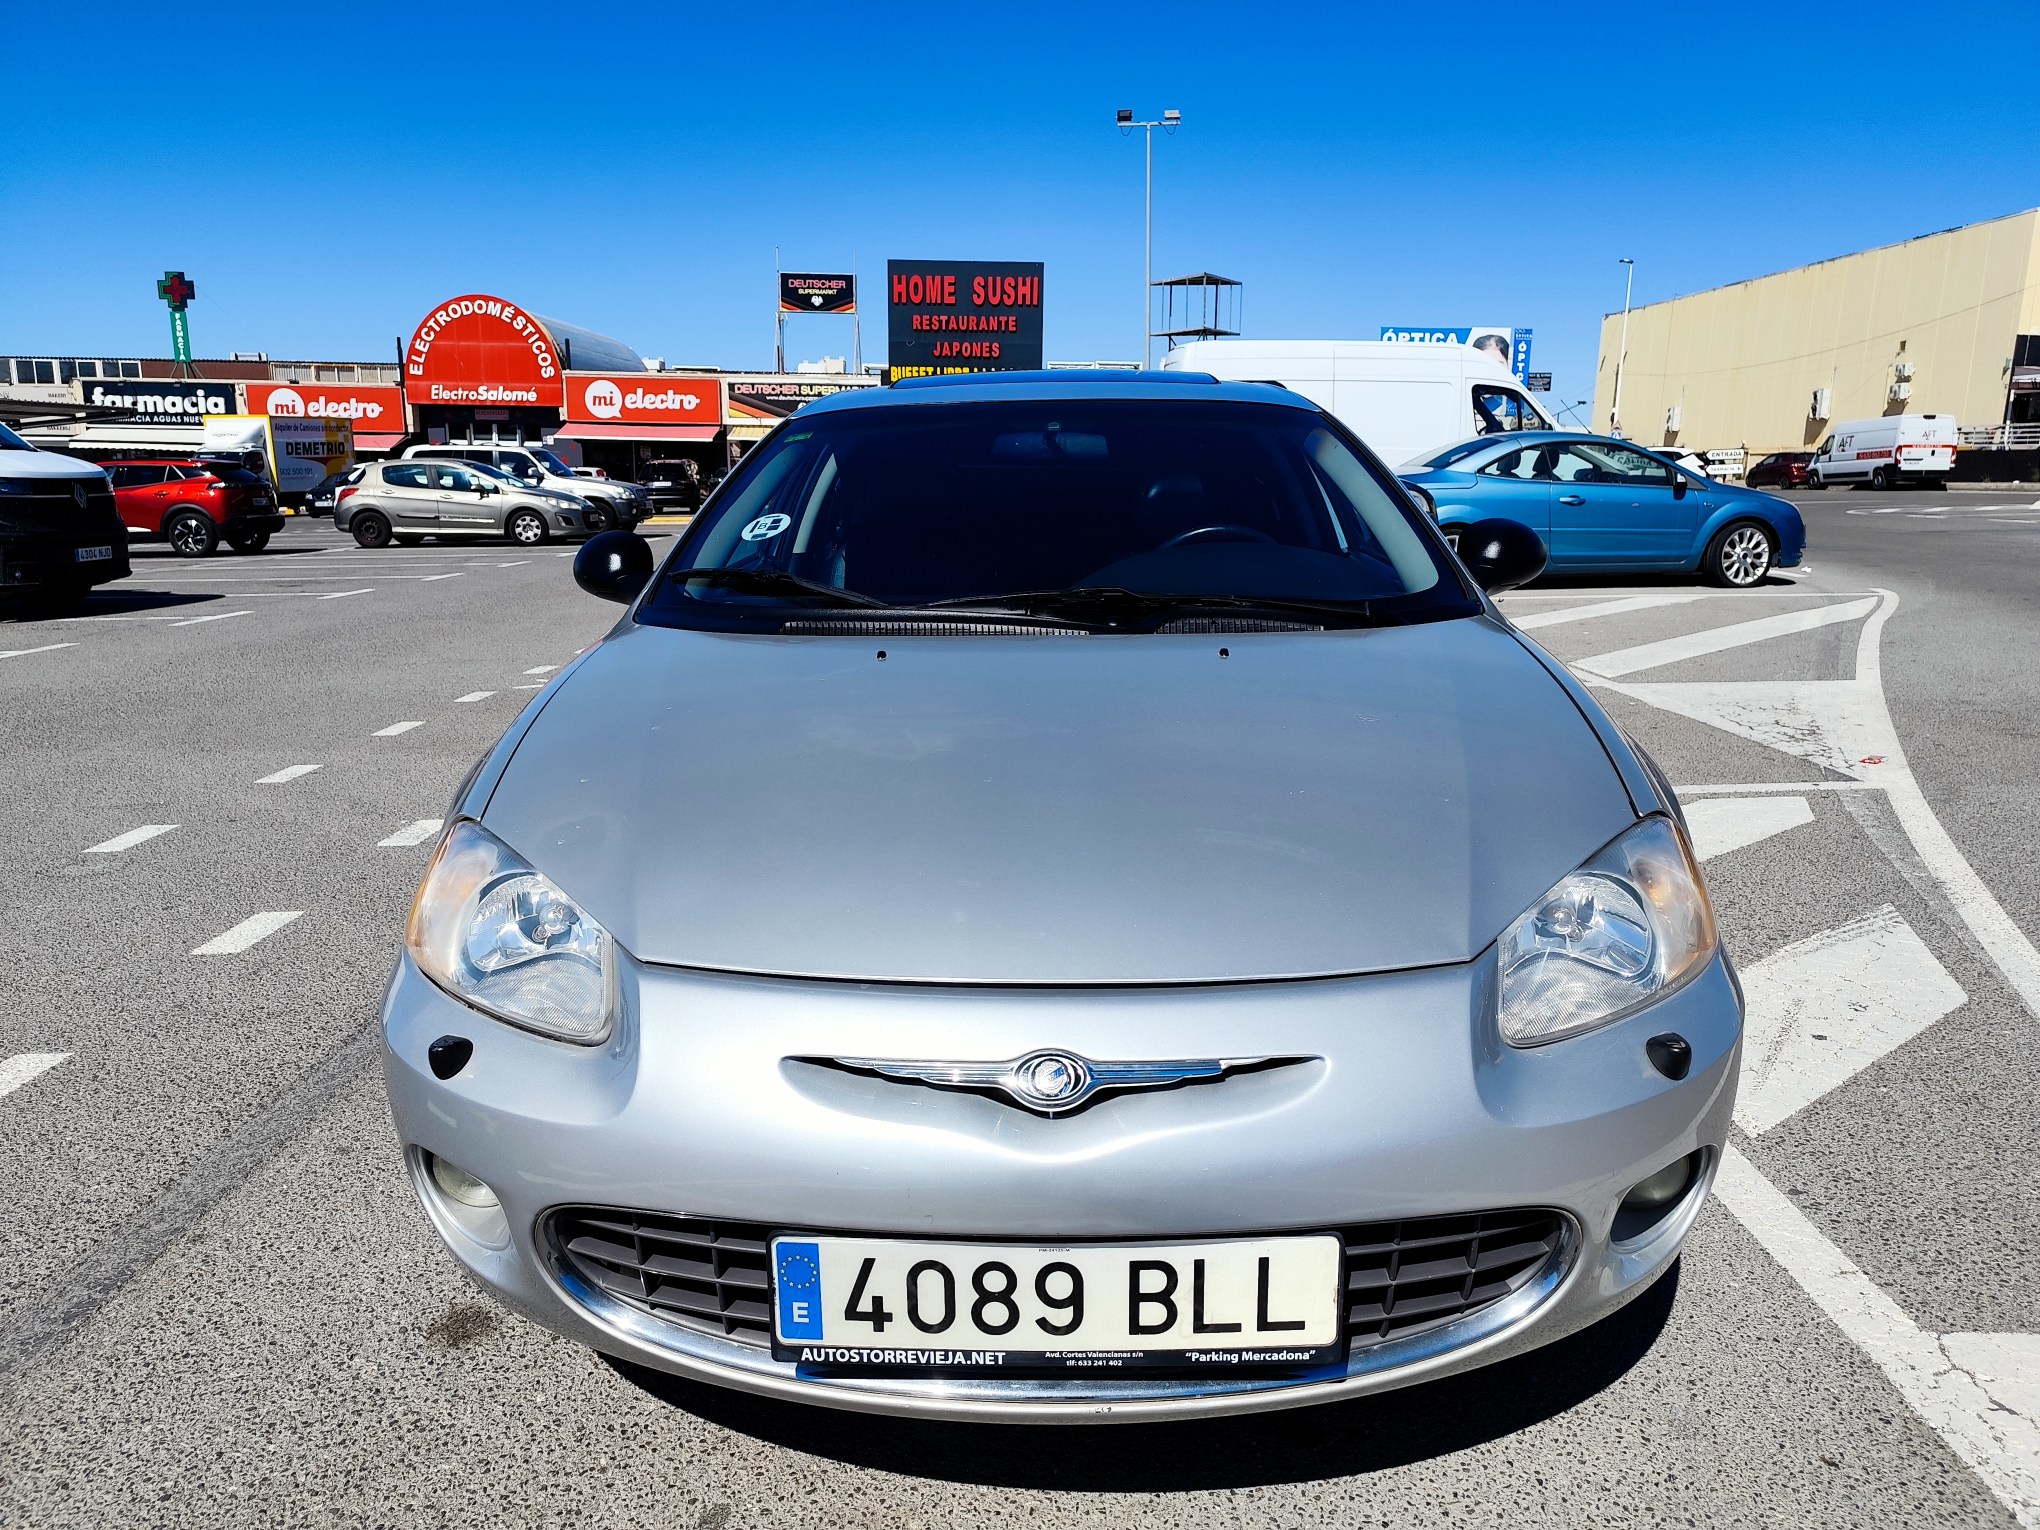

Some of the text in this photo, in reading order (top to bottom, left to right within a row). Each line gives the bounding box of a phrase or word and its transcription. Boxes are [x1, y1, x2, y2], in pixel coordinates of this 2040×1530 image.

[788, 279, 846, 289] DEUTSCHER
[893, 274, 1039, 306] HOME SUSHI
[912, 314, 1017, 332] RESTAURANTE
[175, 313, 186, 361] FARMACIA
[409, 299, 555, 379] ELECTRODOMÉSTICOS
[933, 341, 1000, 358] JAPONES
[431, 385, 538, 402] ElectroSalomé
[735, 384, 799, 395] DEUTSCHER
[92, 387, 226, 414] farmacia
[275, 396, 384, 418] mi electro
[593, 388, 701, 410] mi electro
[153, 415, 181, 423] AGUAS
[275, 422, 293, 433] Alquiler
[293, 423, 299, 432] de
[300, 423, 321, 432] Camiones
[286, 441, 345, 456] DEMETRIO
[280, 467, 291, 476] 902
[292, 467, 303, 476] 500
[81, 549, 97, 560] 4304
[844, 1256, 1305, 1336] 4089 BLL
[792, 1301, 810, 1324] E
[801, 1347, 1006, 1366] AUTOSTORREVIEJA.NET
